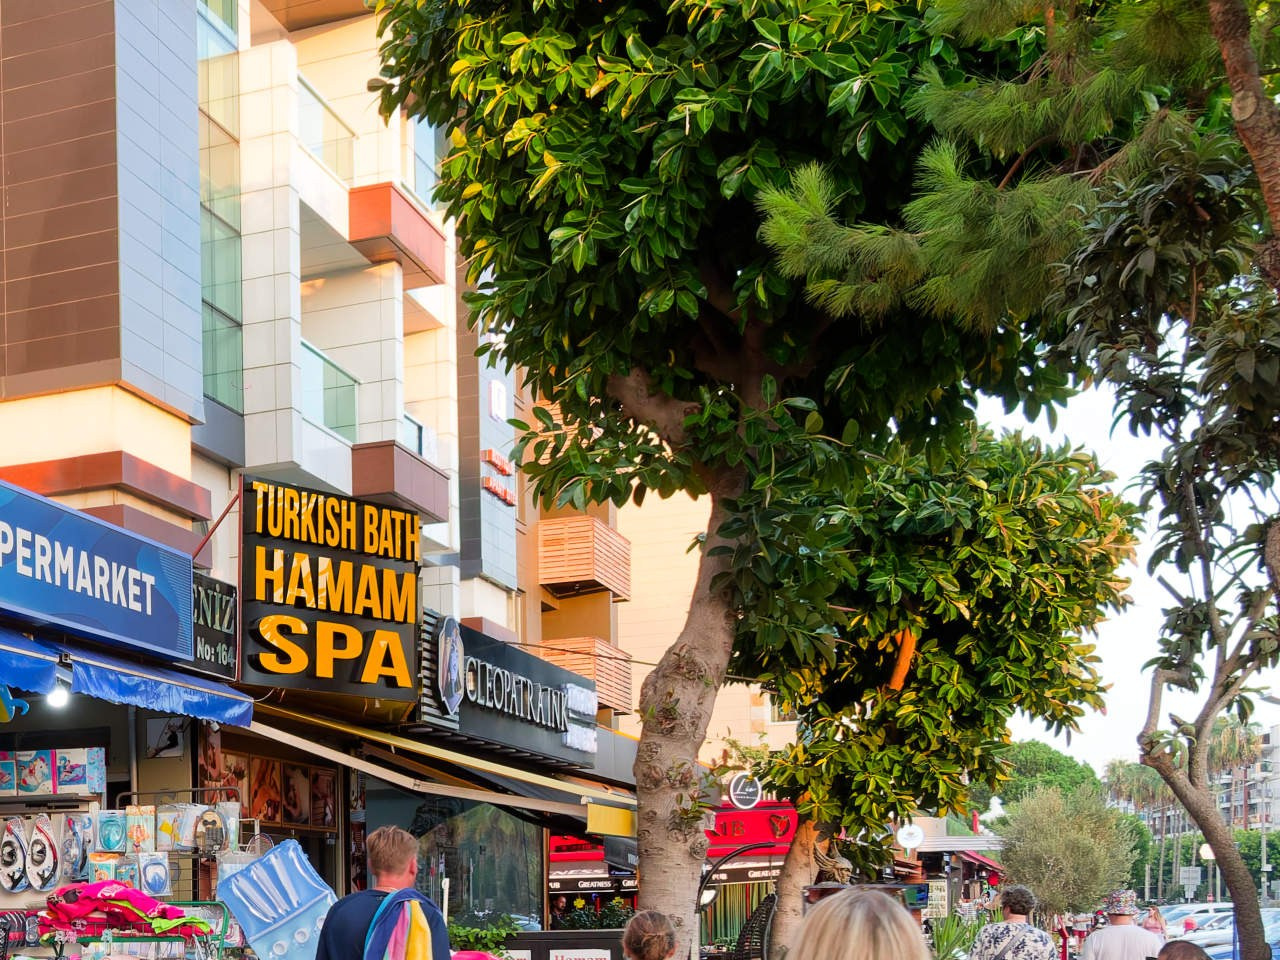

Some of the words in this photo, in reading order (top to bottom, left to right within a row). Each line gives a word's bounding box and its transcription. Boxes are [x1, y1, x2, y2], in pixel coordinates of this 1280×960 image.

[251, 480, 357, 551] TURKISH
[362, 504, 420, 562] BATH
[255, 544, 417, 625] HAMAM
[197, 636, 215, 662] No:
[258, 614, 414, 689] SPA
